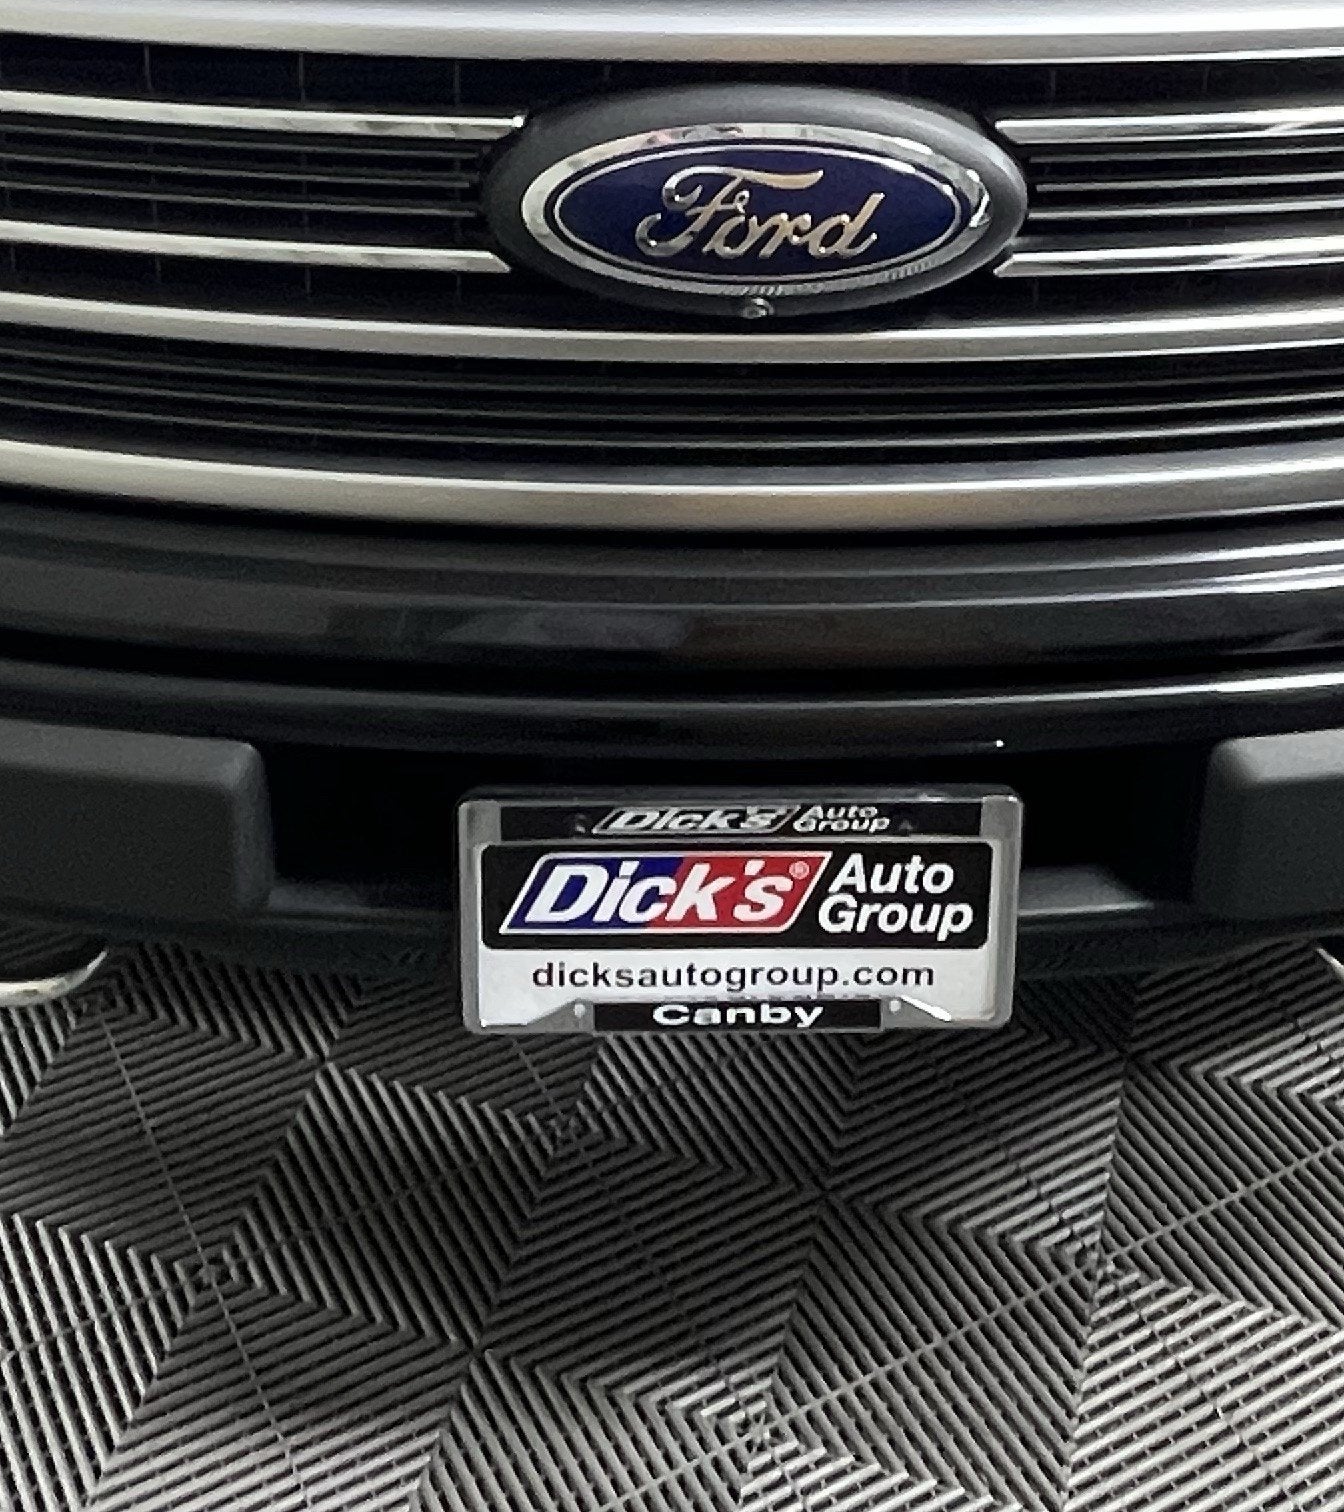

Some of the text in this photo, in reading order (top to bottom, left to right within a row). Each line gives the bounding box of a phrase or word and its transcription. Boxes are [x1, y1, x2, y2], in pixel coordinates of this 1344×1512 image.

[635, 166, 886, 258] Ford
[611, 806, 782, 832] Dick's
[793, 816, 891, 834] Group
[804, 805, 878, 819] Auto
[828, 852, 955, 894] Auto
[523, 859, 795, 922] Dick's
[818, 896, 974, 942] Group
[532, 962, 935, 992] dicksautogroup.com
[652, 1002, 824, 1029] Canby
